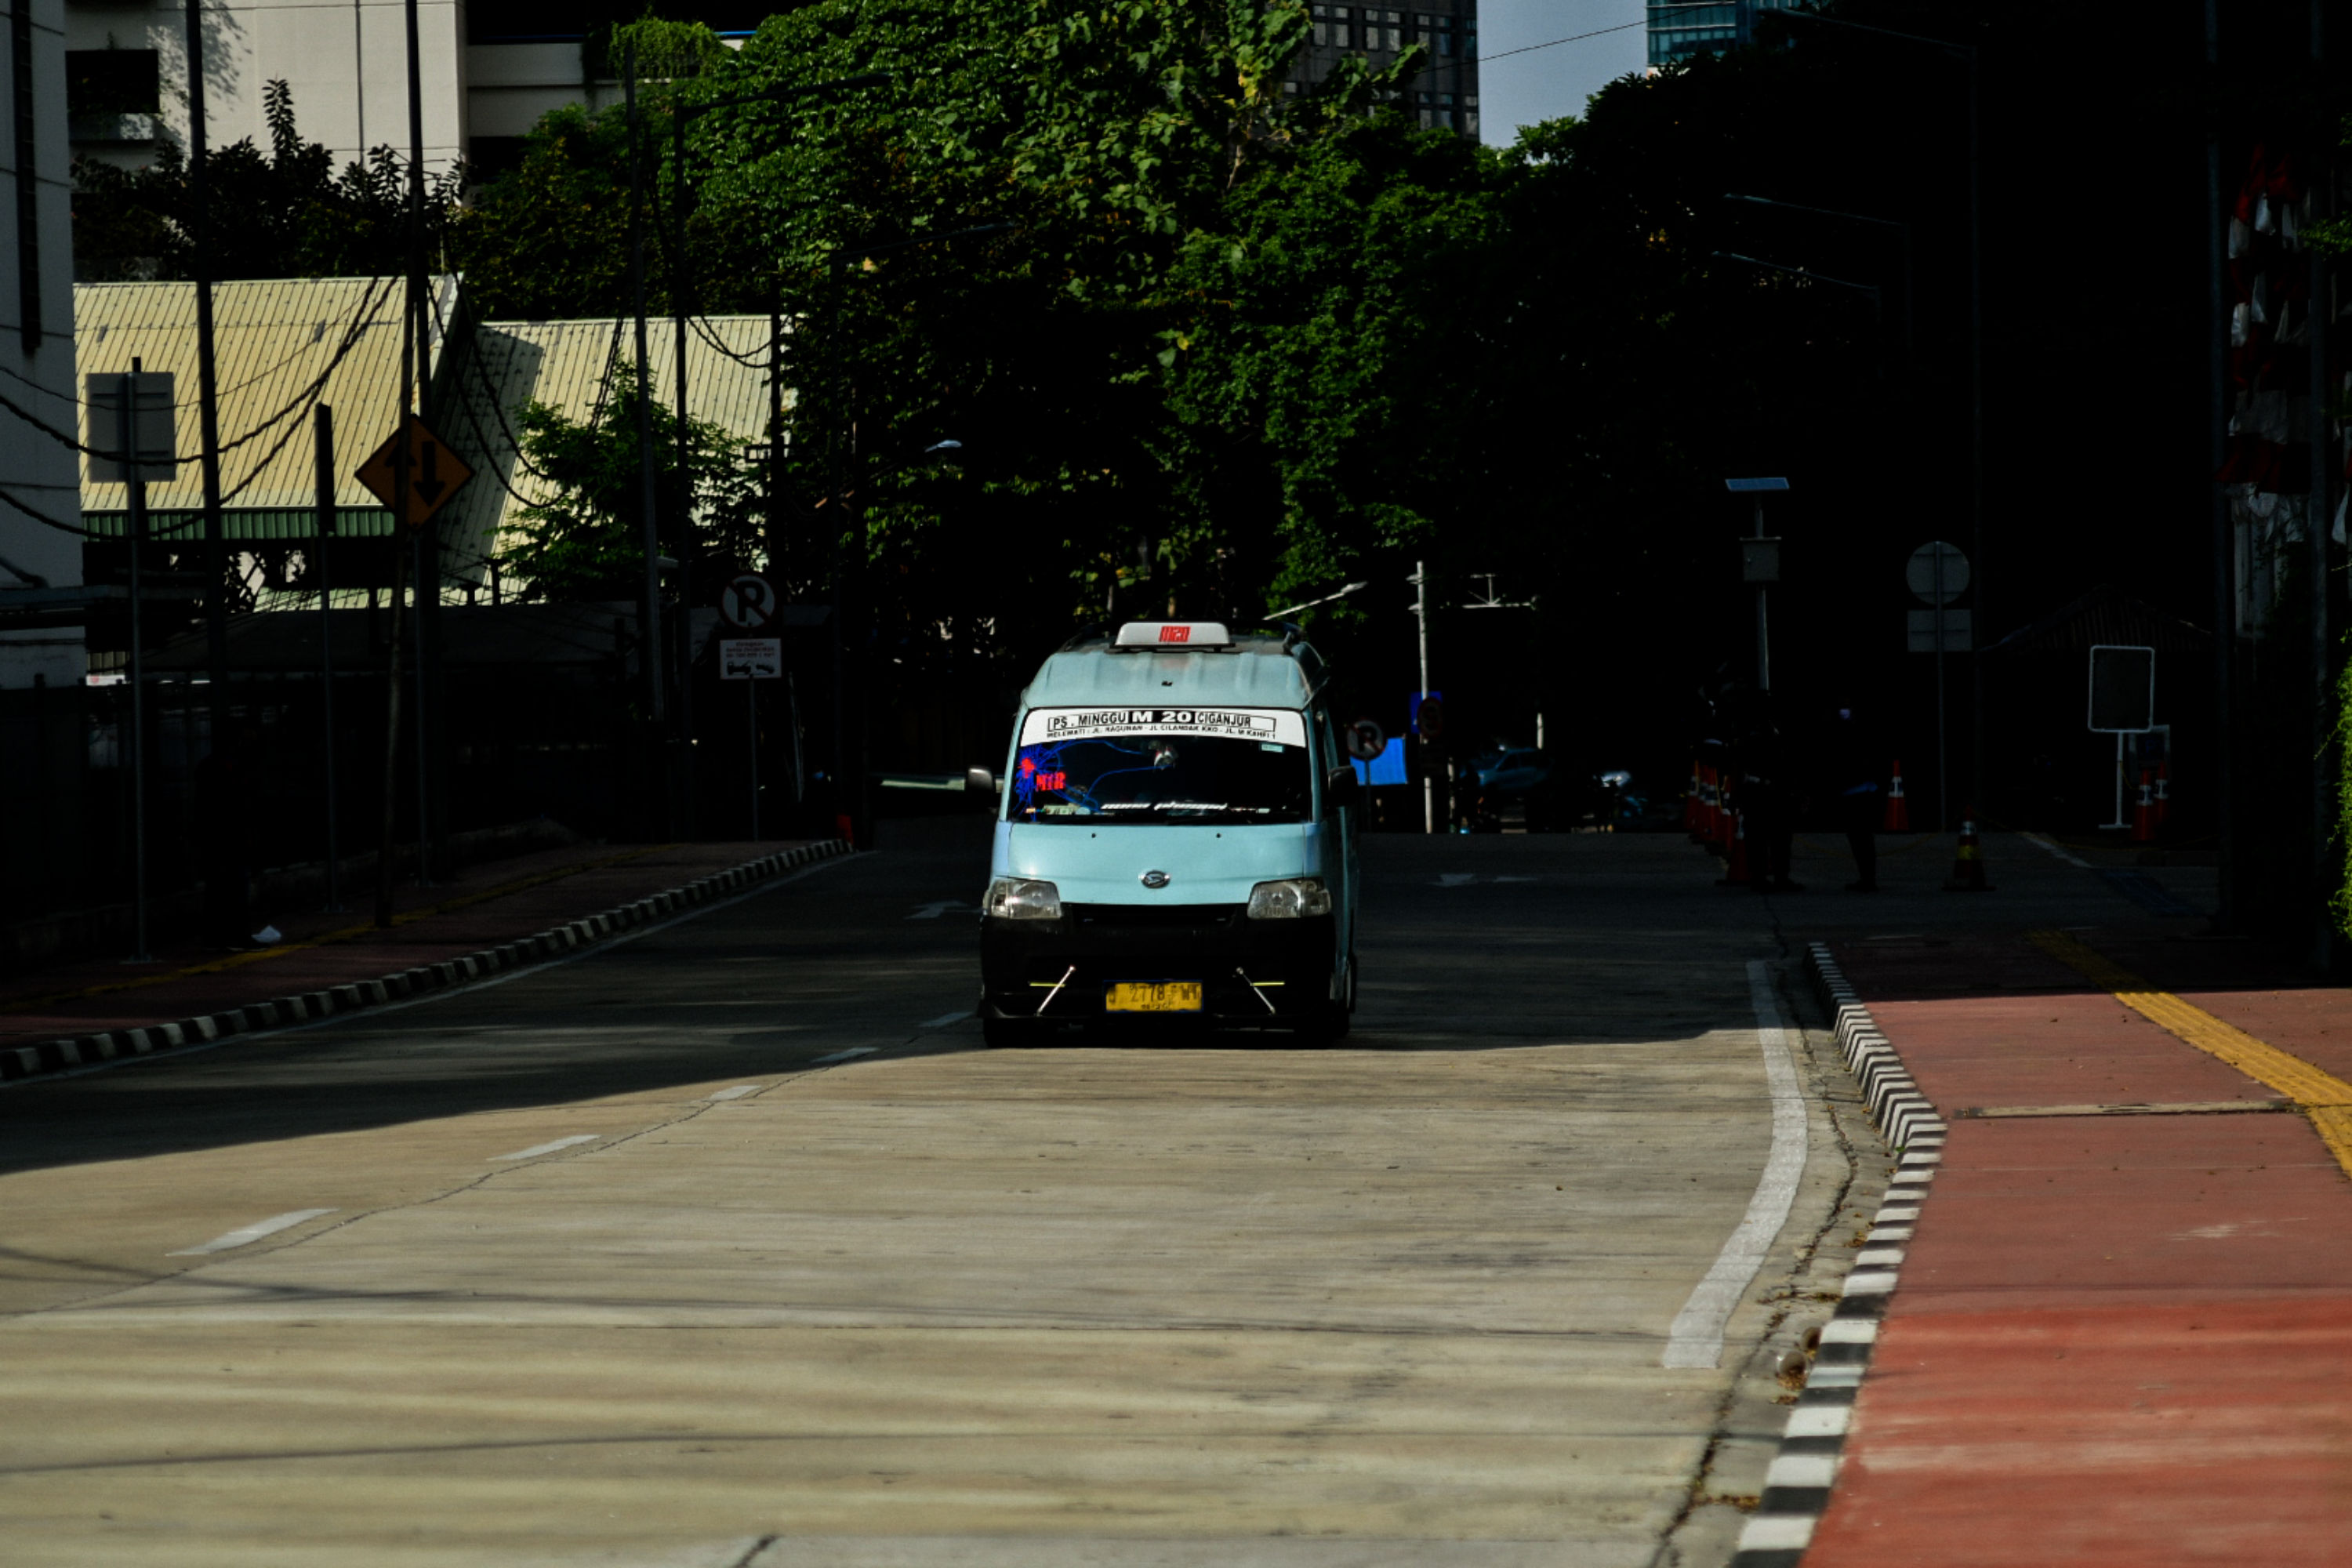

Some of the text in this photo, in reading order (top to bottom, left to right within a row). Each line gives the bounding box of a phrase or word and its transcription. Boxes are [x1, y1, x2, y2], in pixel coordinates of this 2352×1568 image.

[1079, 713, 1126, 726] MINGGU
[1132, 711, 1153, 722] M
[1161, 711, 1192, 722] 20
[1198, 712, 1250, 728] CIGANJUR
